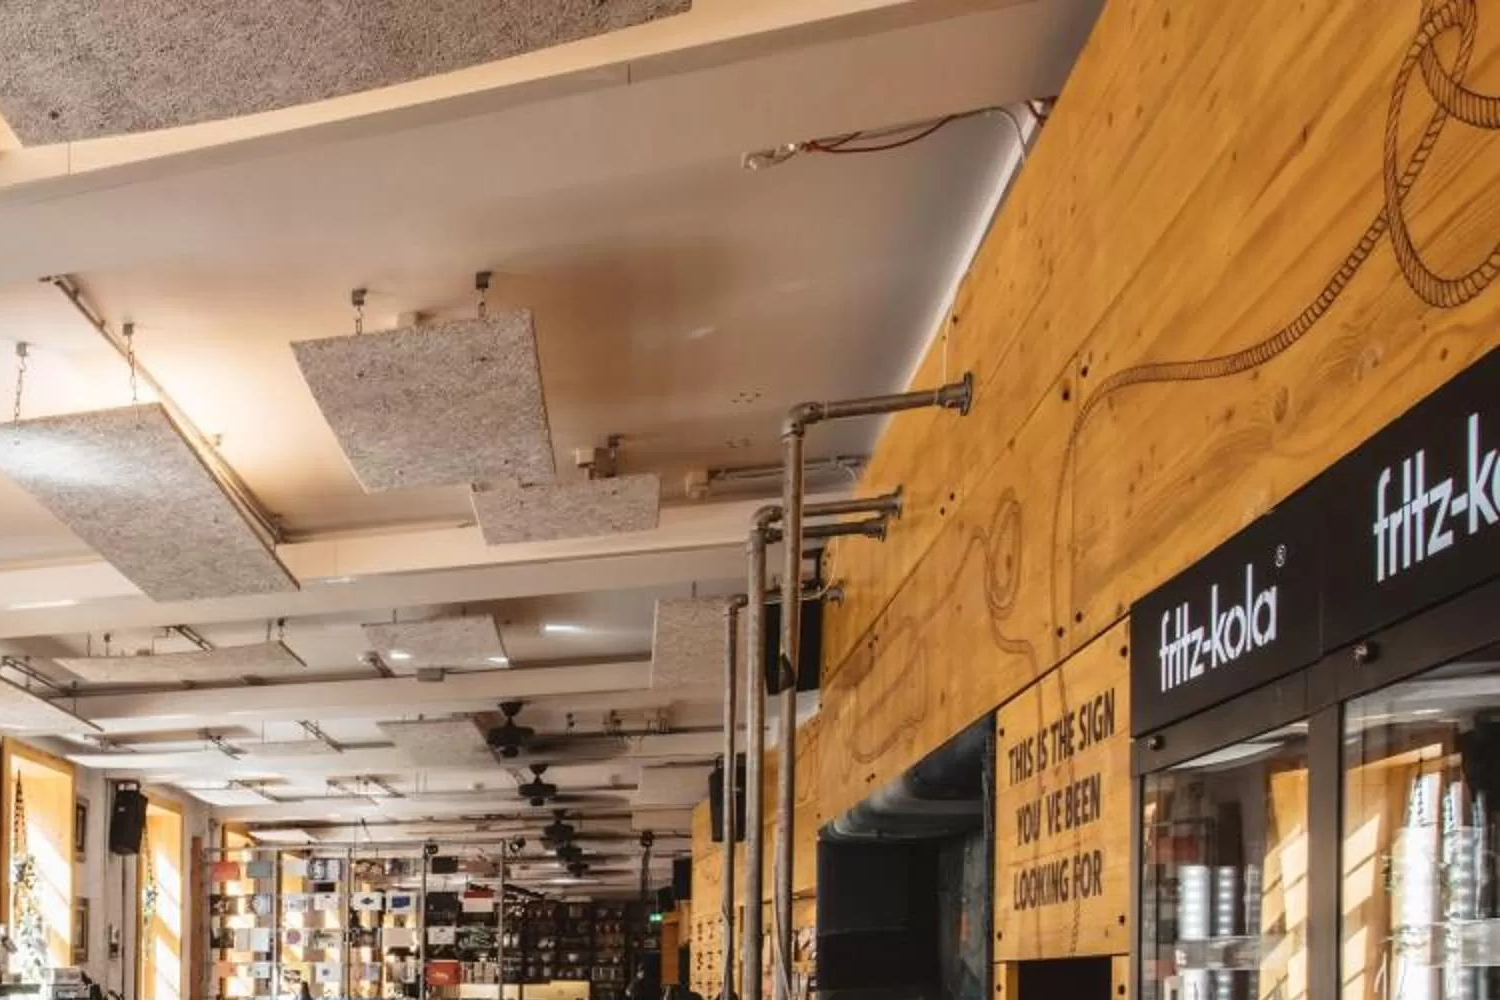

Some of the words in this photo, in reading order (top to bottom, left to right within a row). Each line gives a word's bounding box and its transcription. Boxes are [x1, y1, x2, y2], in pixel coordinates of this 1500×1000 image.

[1373, 412, 1500, 583] fritz-k
[1160, 562, 1277, 693] fritz-kola
[1008, 737, 1034, 787] THIS
[1036, 728, 1048, 773] IS
[1051, 711, 1075, 766] THE
[1078, 688, 1115, 751] SIGN
[1065, 772, 1101, 829] BEEN
[1013, 856, 1069, 911] LOOKING
[1073, 849, 1103, 899] FOR
